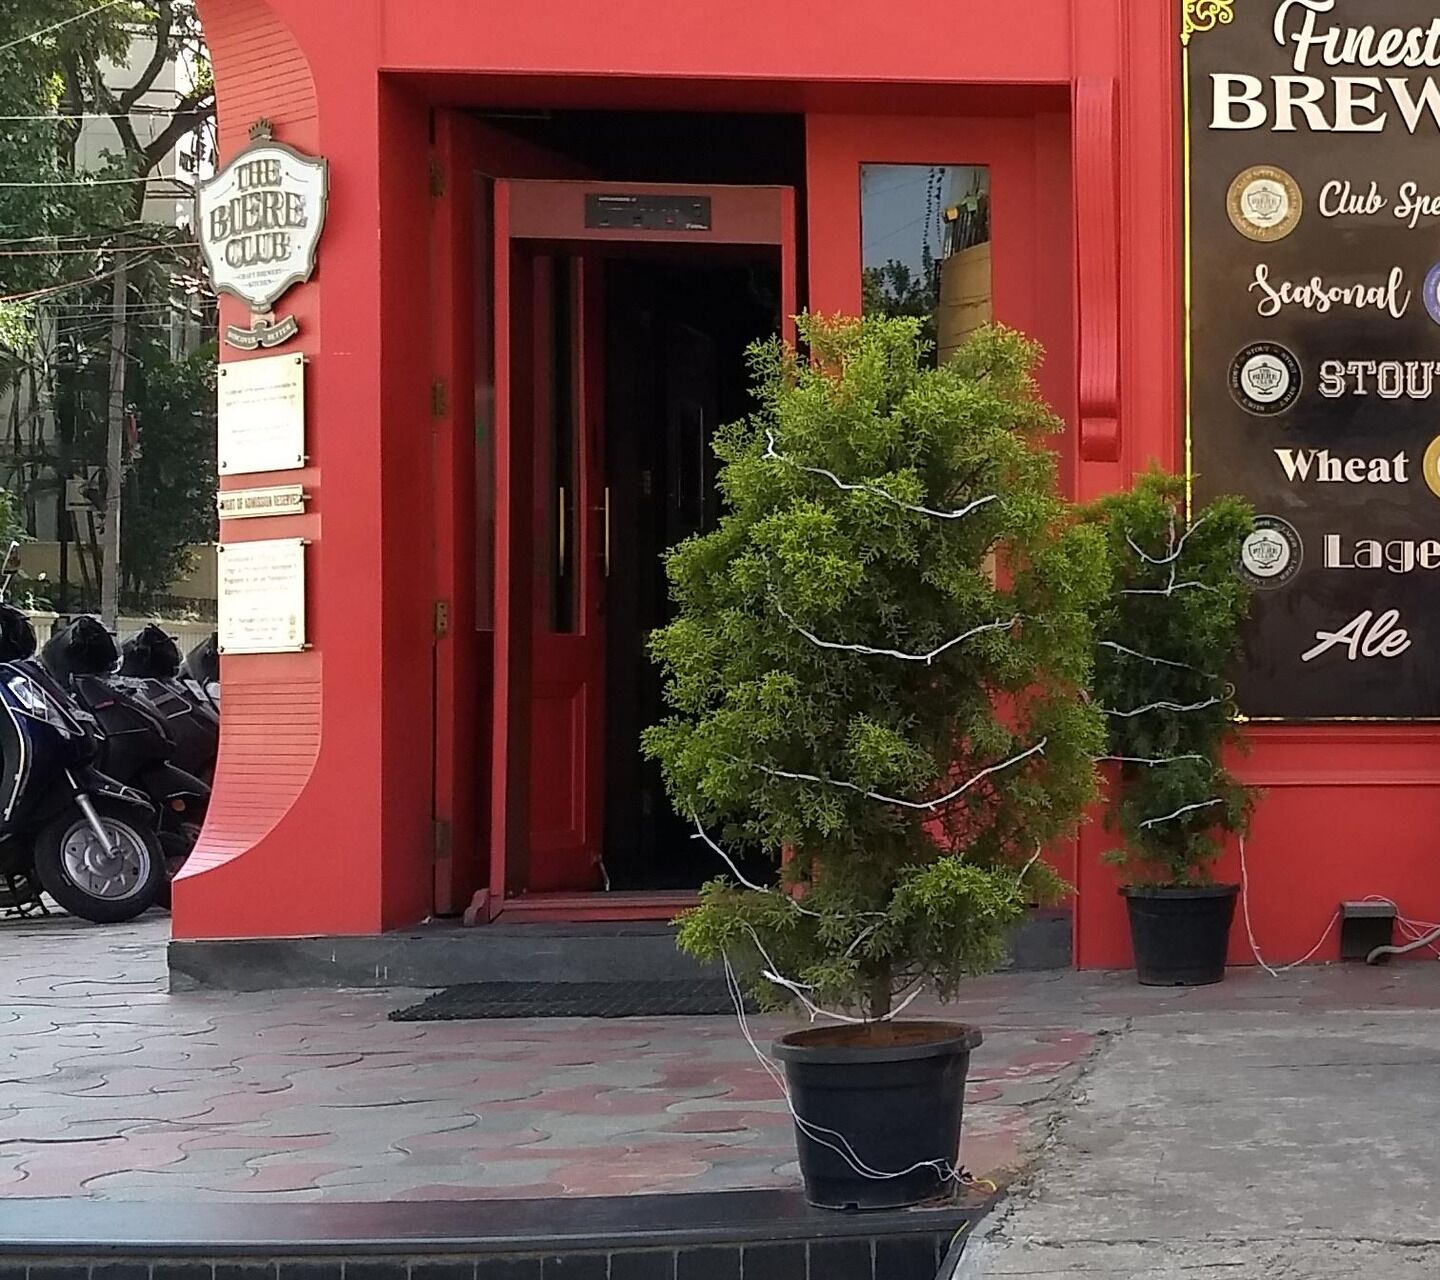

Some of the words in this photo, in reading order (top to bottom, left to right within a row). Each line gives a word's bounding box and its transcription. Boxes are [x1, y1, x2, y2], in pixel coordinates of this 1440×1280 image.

[234, 158, 282, 193] THE
[208, 190, 308, 245] BIERE
[1318, 180, 1388, 218] Club
[225, 231, 292, 269] CLUB
[1249, 263, 1412, 318] Seasonal
[1273, 448, 1409, 483] Wheat
[1301, 609, 1411, 662] Ale
